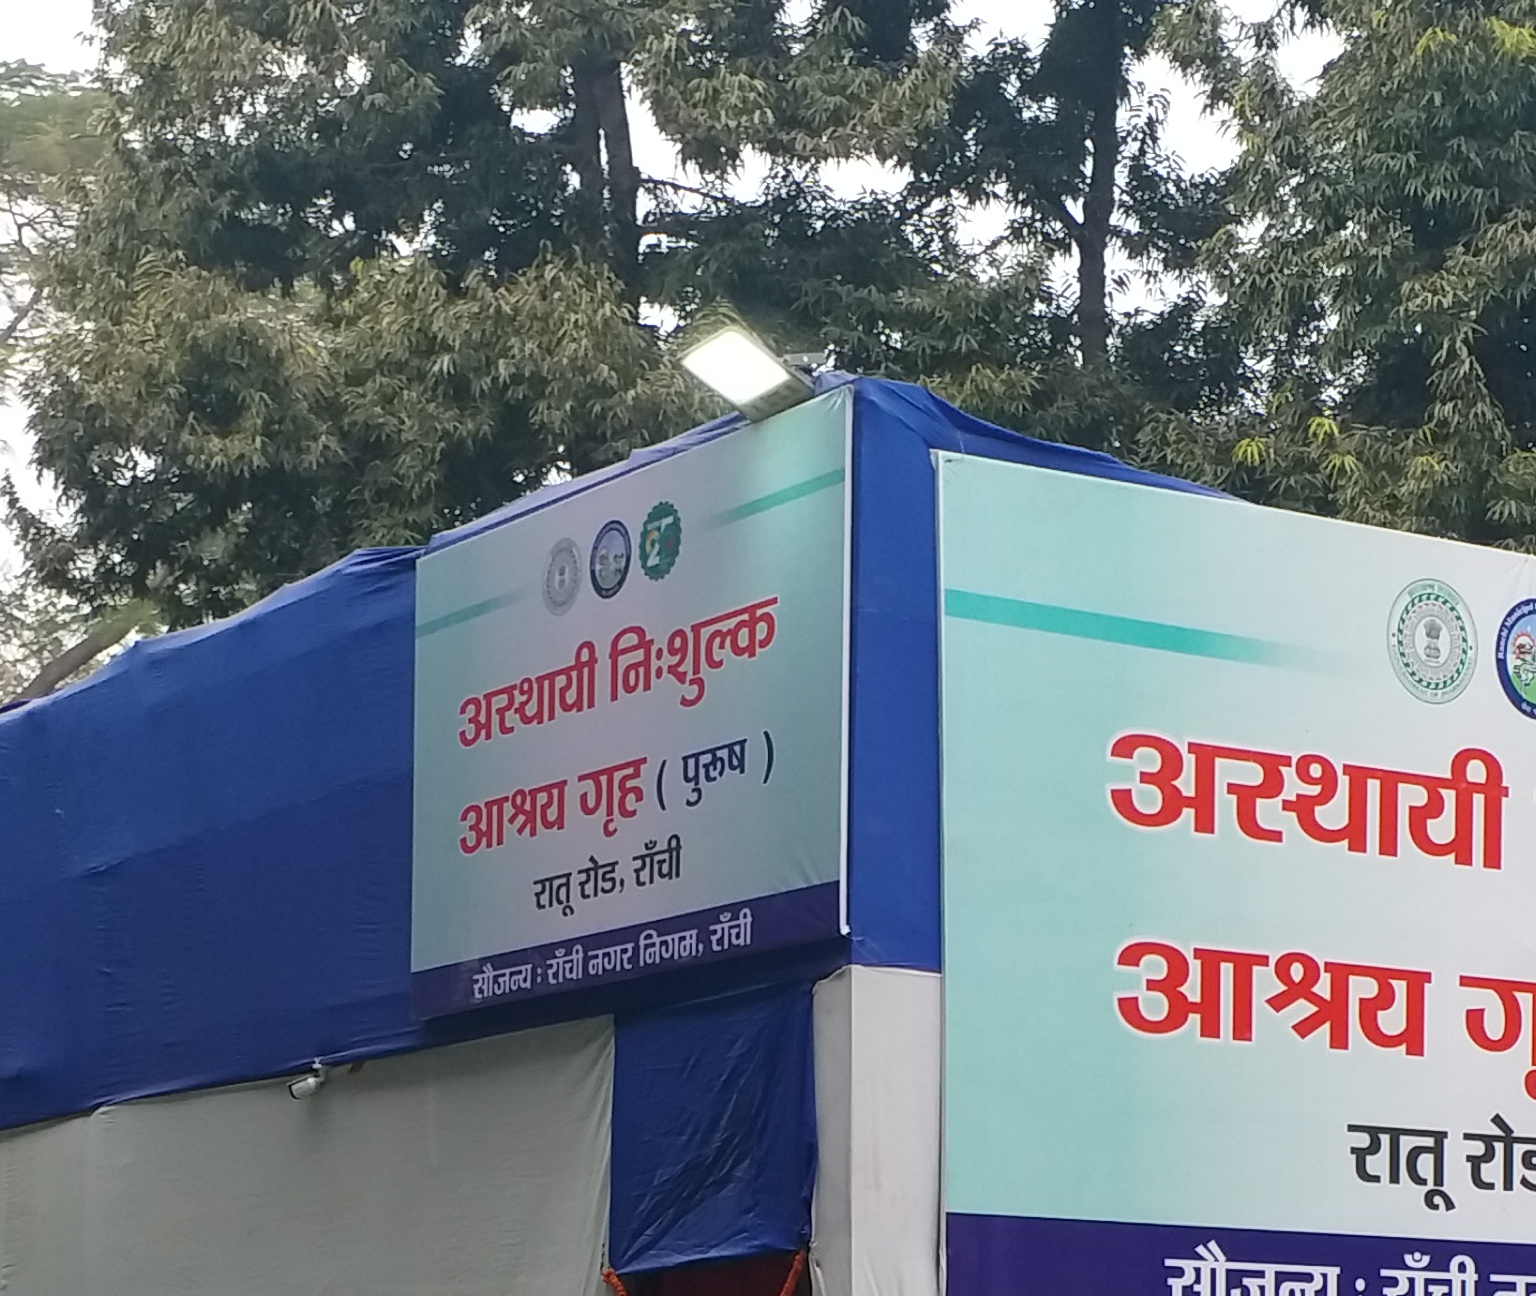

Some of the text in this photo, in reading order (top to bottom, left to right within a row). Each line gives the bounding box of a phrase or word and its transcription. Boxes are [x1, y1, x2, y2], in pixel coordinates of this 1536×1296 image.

[460, 641, 597, 748] अस्थायी
[459, 779, 568, 855] आश्रय
[577, 757, 648, 838] गृह
[1110, 733, 1509, 870] अस्थायी
[533, 871, 575, 917] रातू
[577, 855, 625, 900] रोड,
[472, 962, 533, 999] सौजन्य
[587, 942, 635, 975] नगर
[1117, 941, 1433, 1058] आश्रय
[1347, 1123, 1456, 1212] रातू
